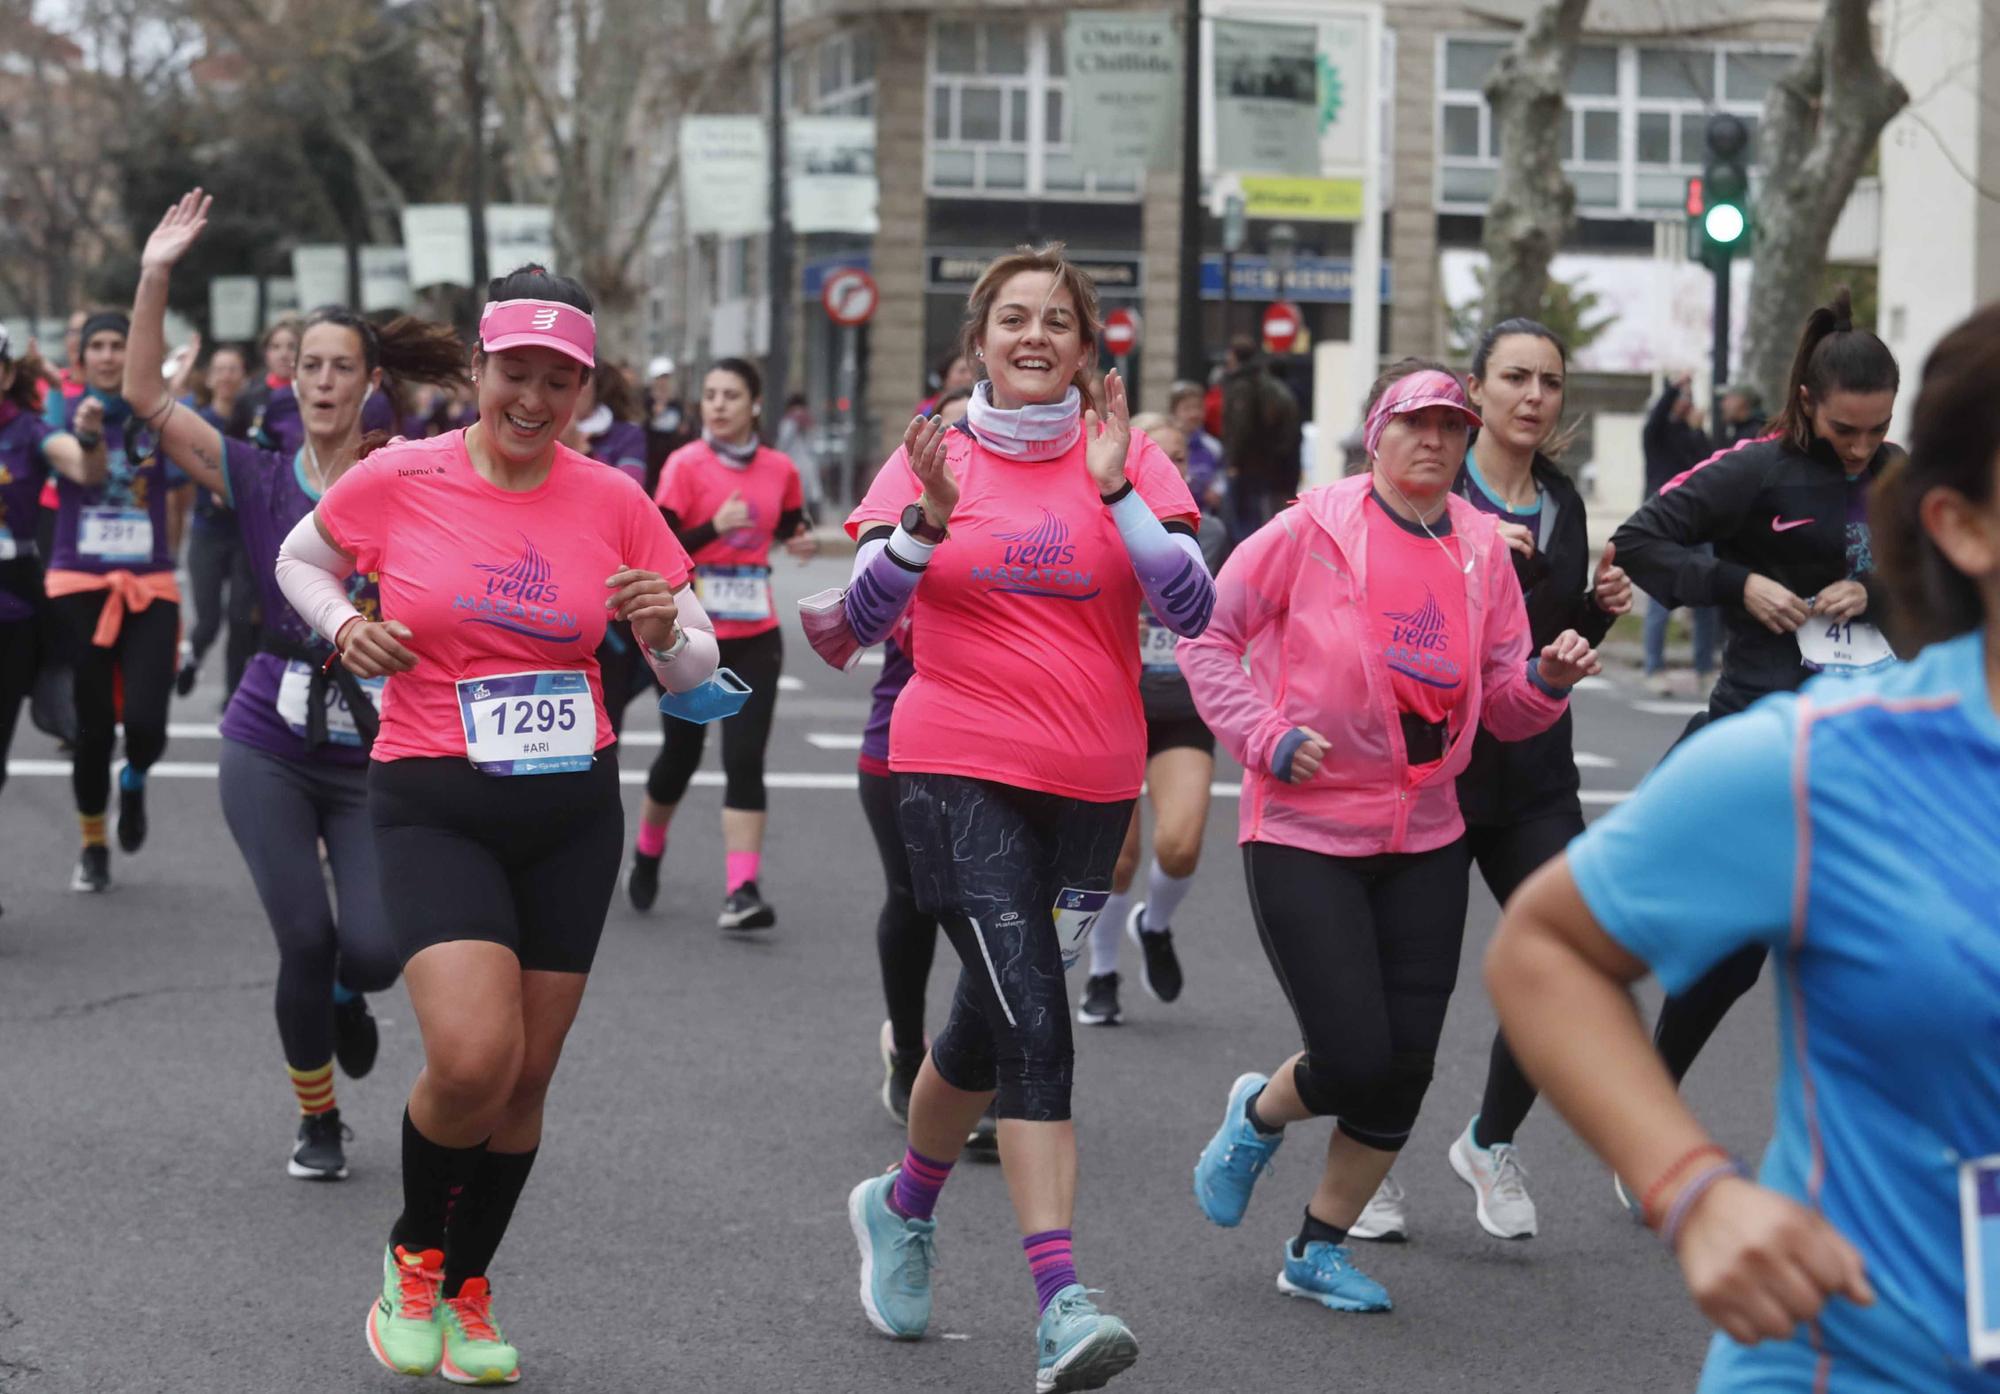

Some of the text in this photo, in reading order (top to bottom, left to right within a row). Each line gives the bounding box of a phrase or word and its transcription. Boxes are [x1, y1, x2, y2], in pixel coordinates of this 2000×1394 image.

[1004, 544, 1076, 568] velas
[486, 576, 559, 604] velas
[971, 566, 1093, 587] MARATON
[452, 594, 577, 628] MARATON
[1393, 625, 1449, 652] velas
[1384, 645, 1460, 676] ARATON
[491, 698, 576, 736] 1295
[523, 742, 550, 753] #ARI
